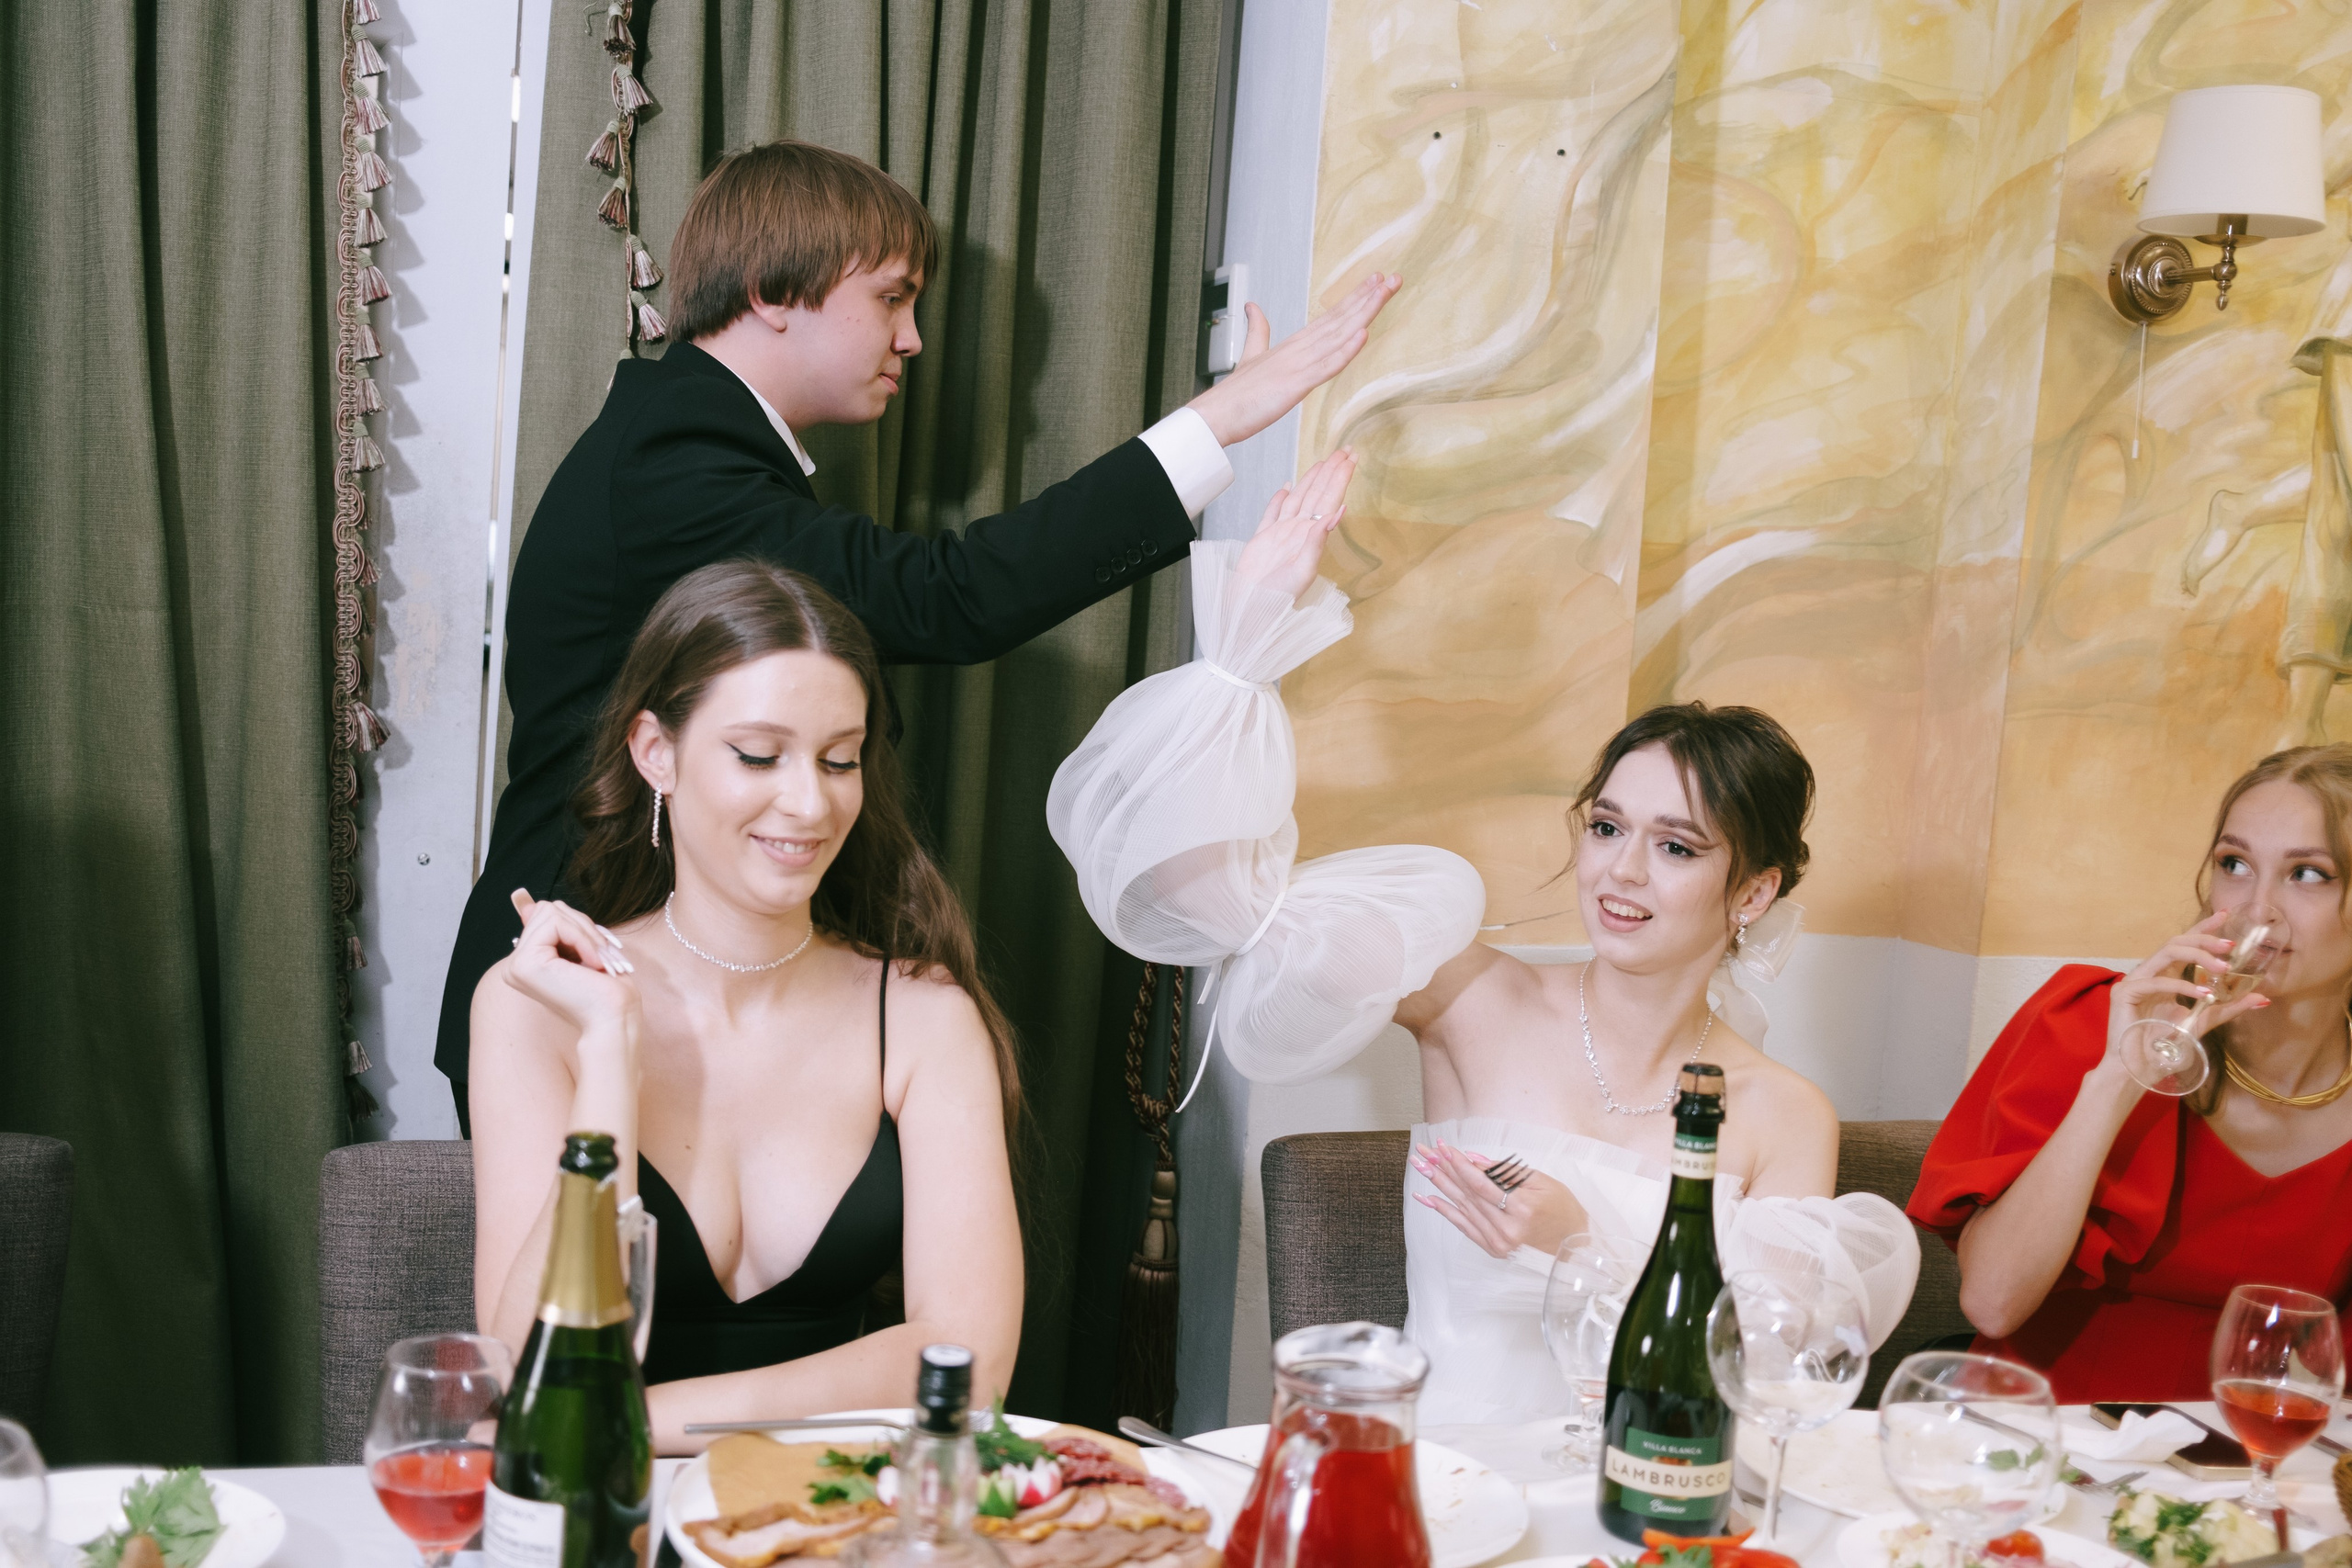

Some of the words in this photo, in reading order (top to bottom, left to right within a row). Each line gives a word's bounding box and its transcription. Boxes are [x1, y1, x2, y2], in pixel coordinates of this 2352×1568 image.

[1643, 1440, 1668, 1452] VILLA
[1668, 1445, 1702, 1455] BLANCA
[1611, 1458, 1726, 1488] LAMBRUSCO
